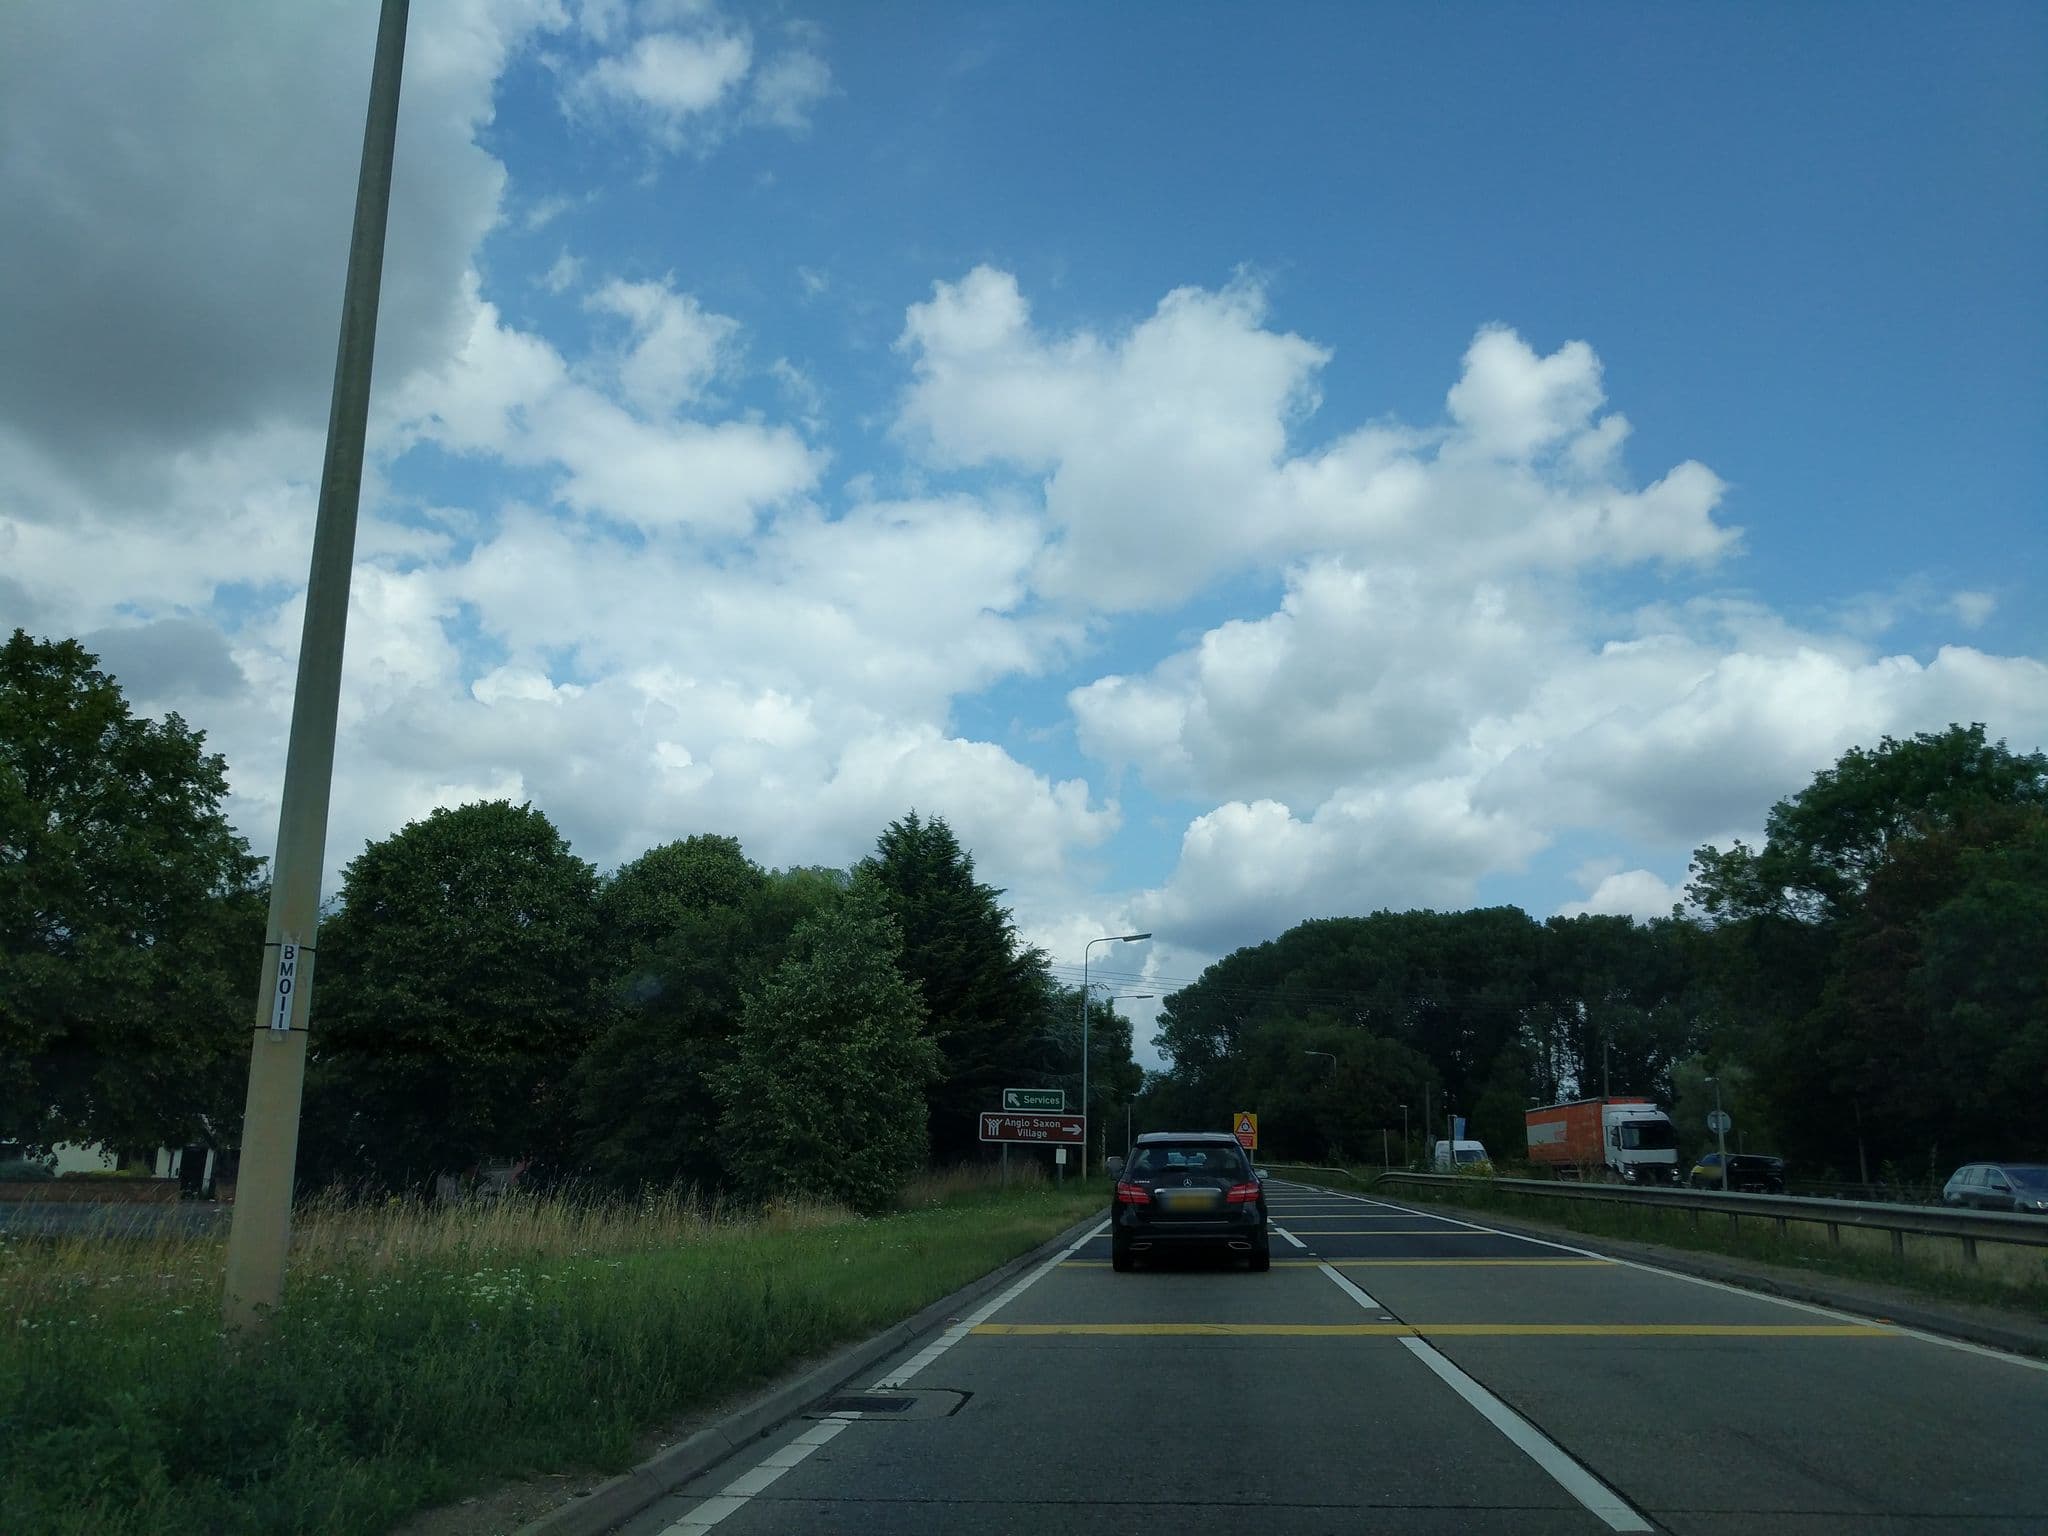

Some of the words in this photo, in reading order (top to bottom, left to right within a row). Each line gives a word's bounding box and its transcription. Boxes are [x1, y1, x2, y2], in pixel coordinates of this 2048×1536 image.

[1023, 1095, 1060, 1105] Services
[1004, 1118, 1030, 1128] Anglo
[1033, 1118, 1061, 1128] Saxon
[1017, 1128, 1048, 1139] Village
